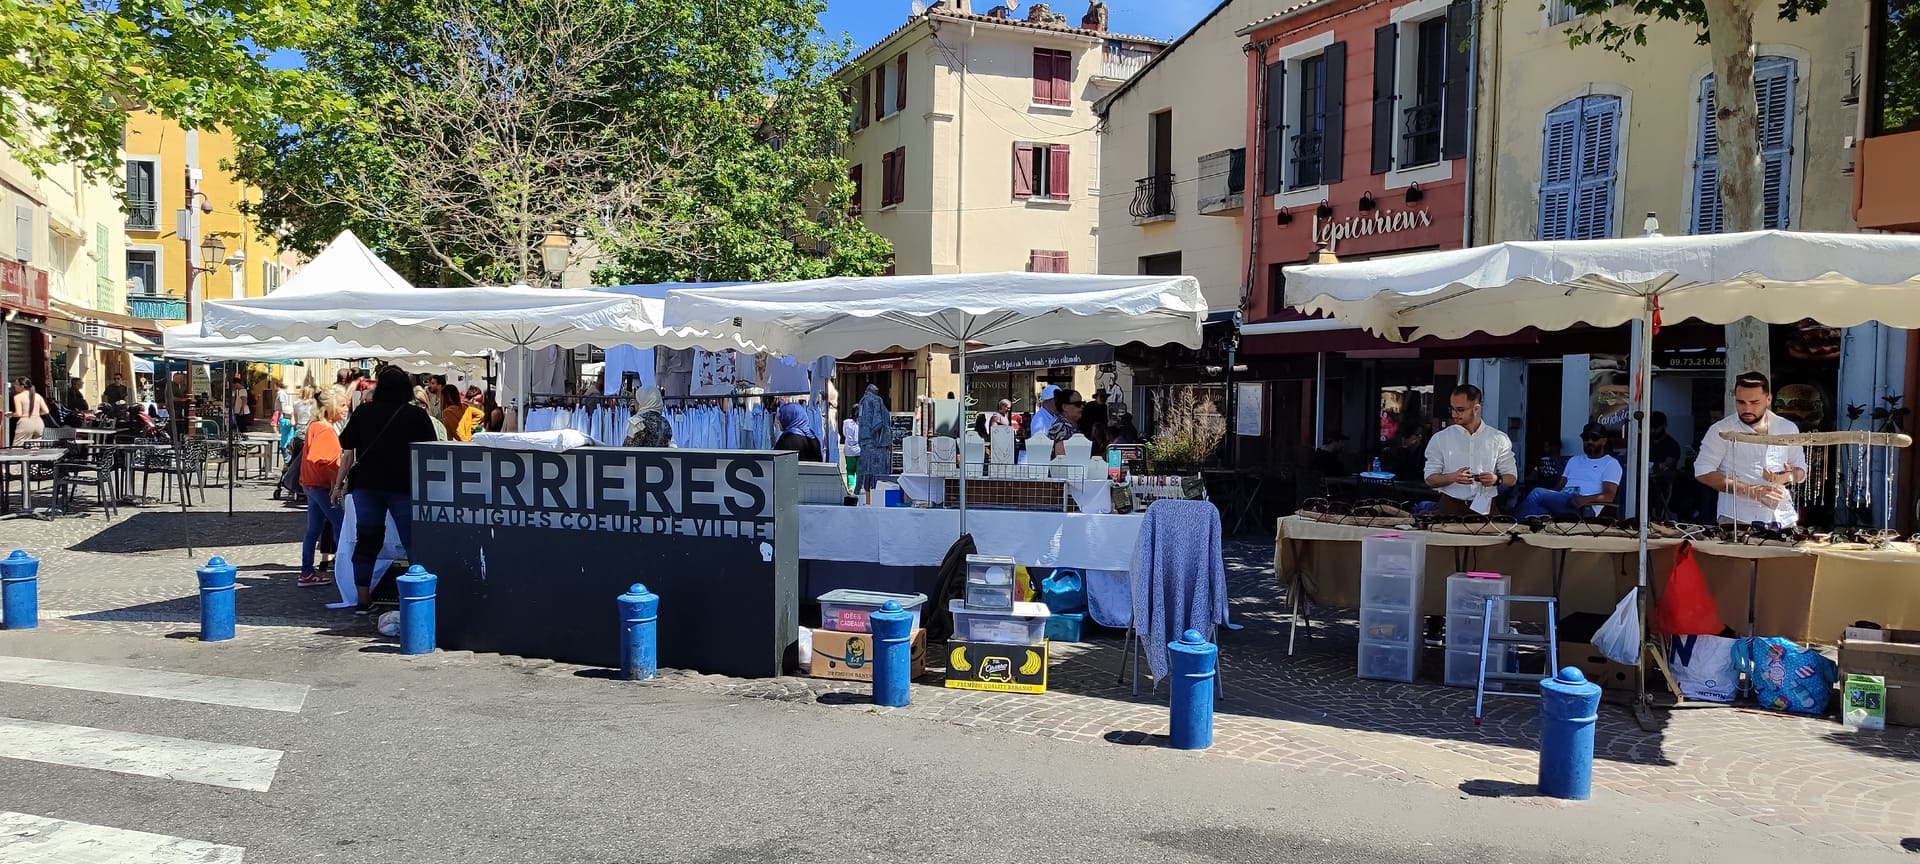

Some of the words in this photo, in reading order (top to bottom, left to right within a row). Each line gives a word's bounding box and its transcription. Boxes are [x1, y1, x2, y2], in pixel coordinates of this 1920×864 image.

[420, 451, 766, 516] FERRIERES
[419, 505, 551, 527] MARTIGUES
[560, 513, 643, 534] COEUR
[653, 516, 682, 535] DE
[695, 518, 766, 539] VILLE
[839, 620, 865, 628] CADEAUX
[843, 611, 862, 620] IDÉES
